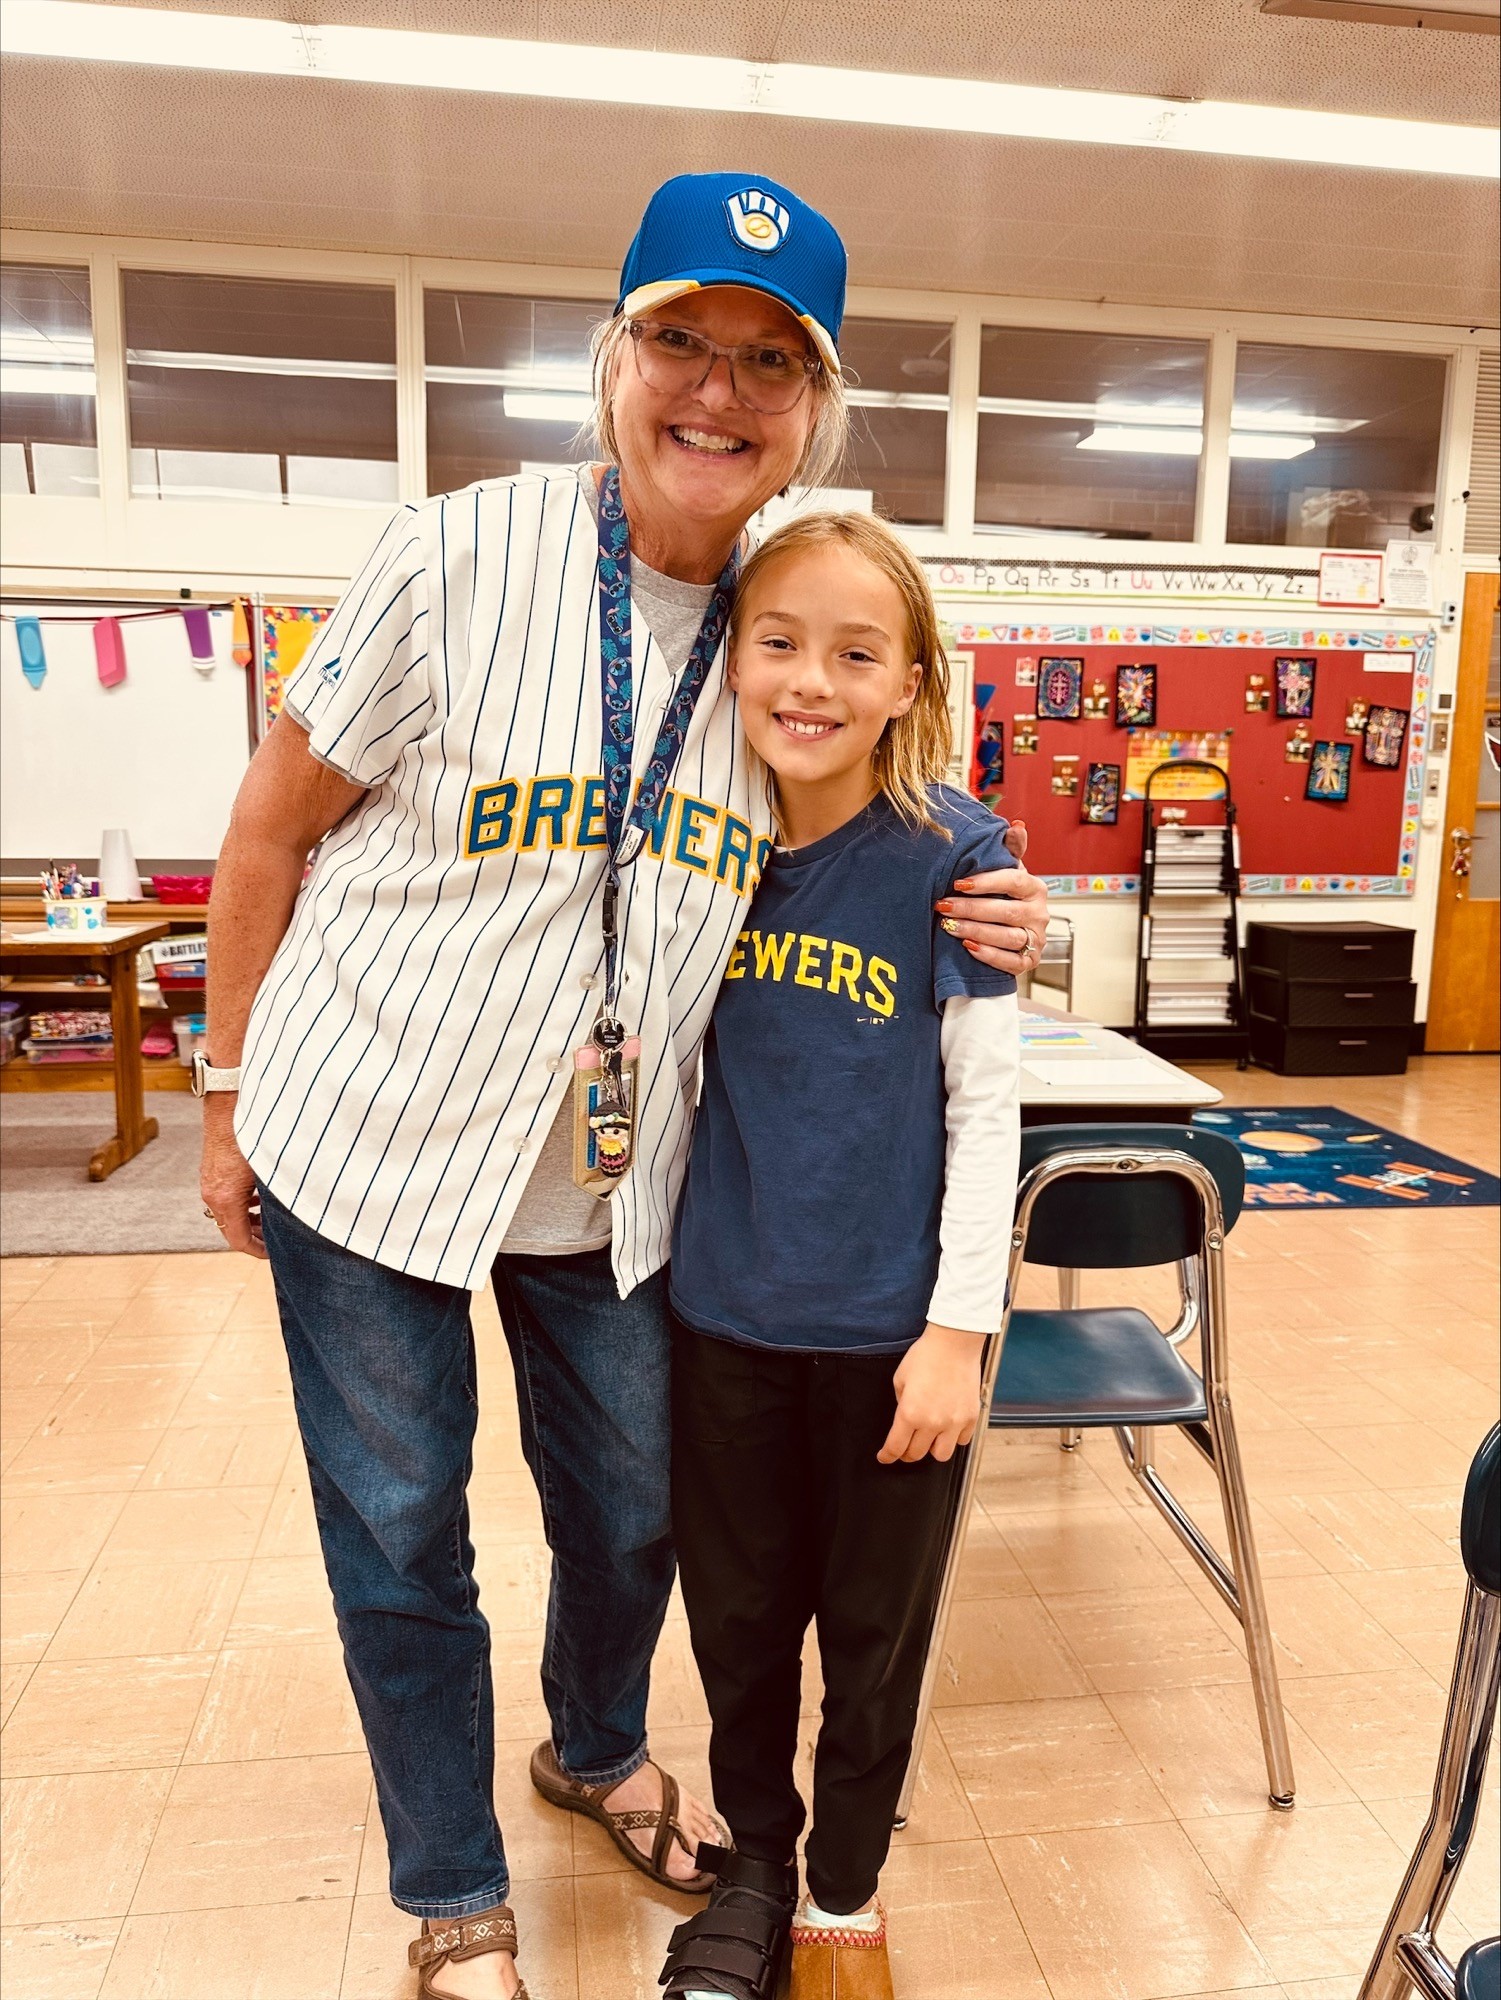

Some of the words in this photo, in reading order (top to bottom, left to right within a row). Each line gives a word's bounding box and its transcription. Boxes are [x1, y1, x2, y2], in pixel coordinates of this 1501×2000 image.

[939, 564, 964, 584] Oo
[973, 567, 995, 593] Pp
[1004, 567, 1029, 594] Qq
[1037, 568, 1059, 587] Rr
[1070, 569, 1090, 588] Ss
[1100, 570, 1119, 589] Tt
[1131, 570, 1152, 590] Uu
[1161, 571, 1183, 590] Vv
[1190, 572, 1216, 591] Ww
[1222, 572, 1244, 591] Xx
[1253, 574, 1273, 600] Yy
[1283, 575, 1304, 594] Zz
